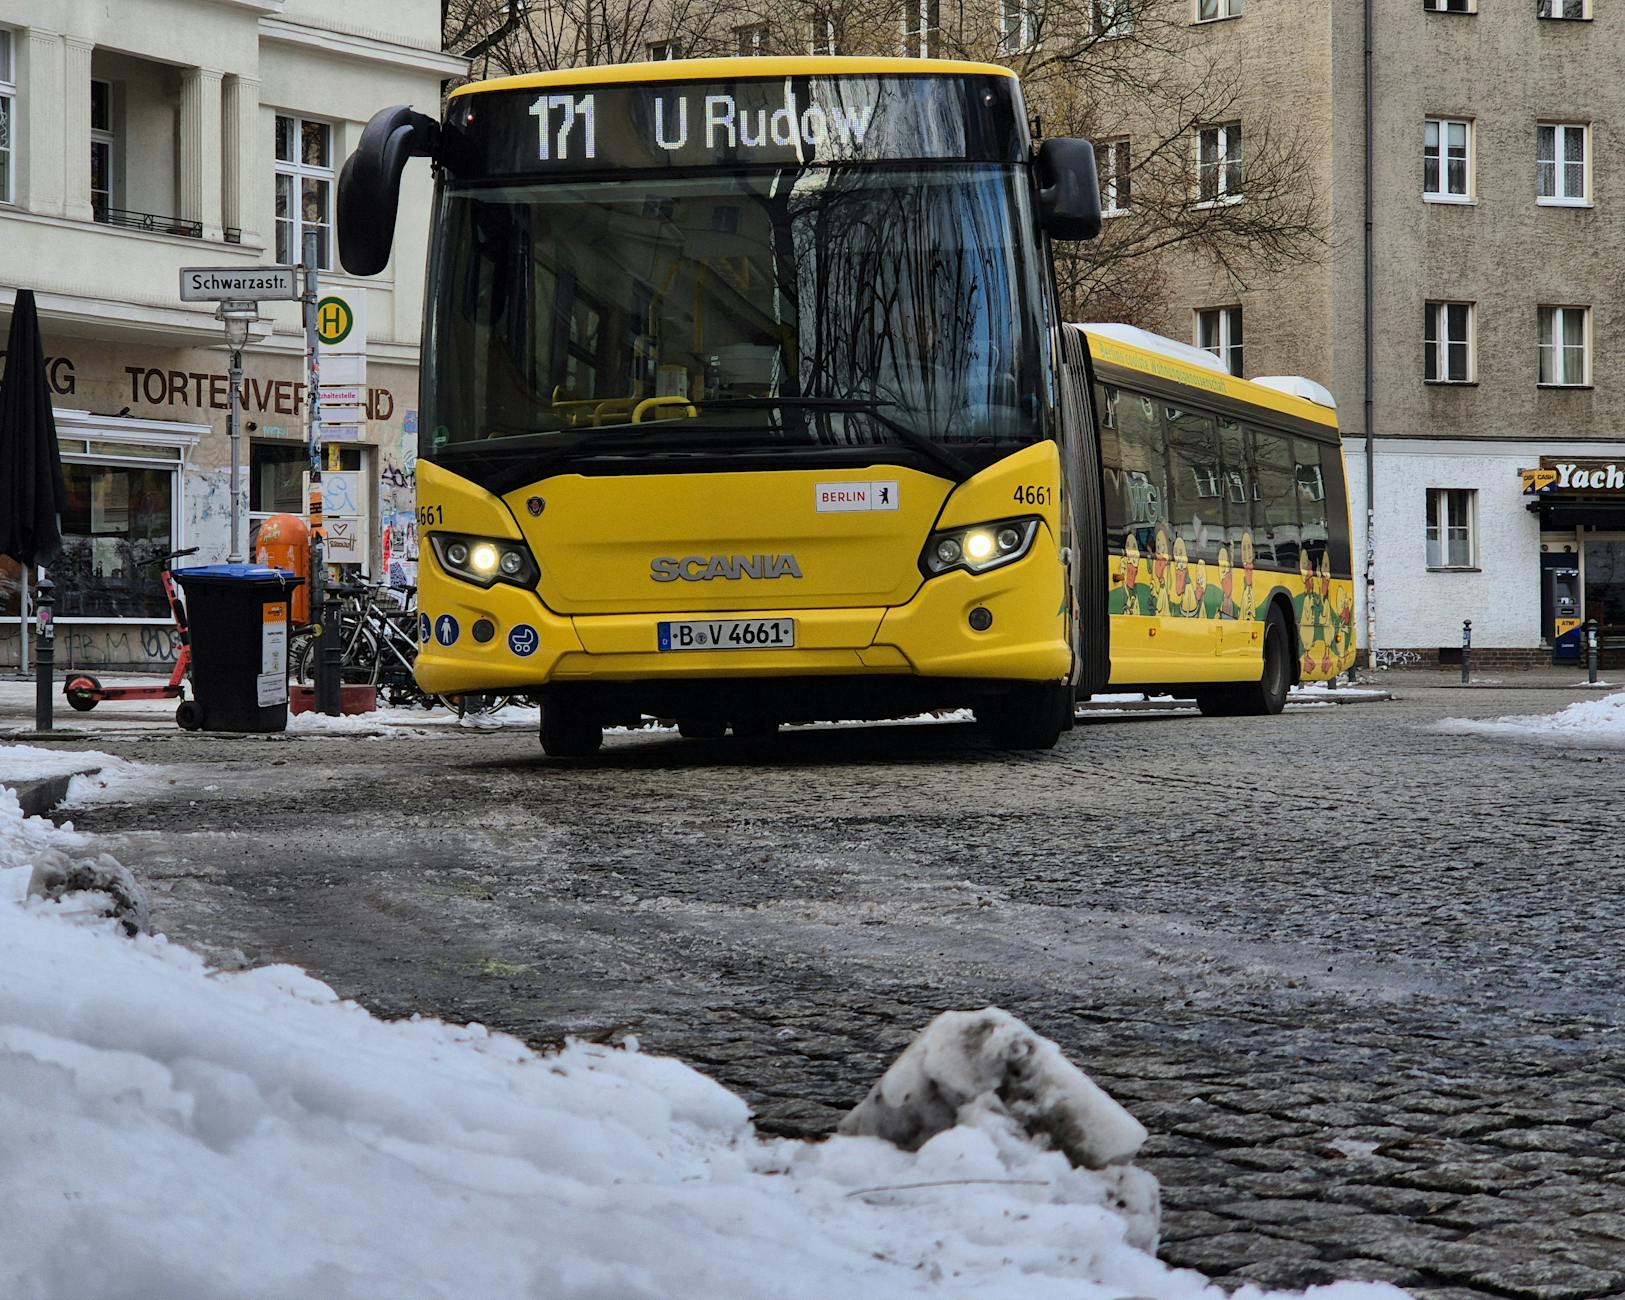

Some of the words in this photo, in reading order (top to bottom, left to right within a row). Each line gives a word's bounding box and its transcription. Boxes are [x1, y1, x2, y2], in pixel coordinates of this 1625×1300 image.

[528, 94, 594, 160] 171
[655, 97, 687, 149] U
[705, 93, 872, 149] Rudow
[192, 274, 287, 290] Schwarzastr.
[323, 306, 339, 334] H
[822, 491, 865, 503] BERLIN
[1013, 485, 1051, 506] 4661
[650, 554, 803, 582] SCANIA
[680, 625, 693, 646] B
[709, 624, 722, 645] V
[729, 622, 783, 645] 4661
